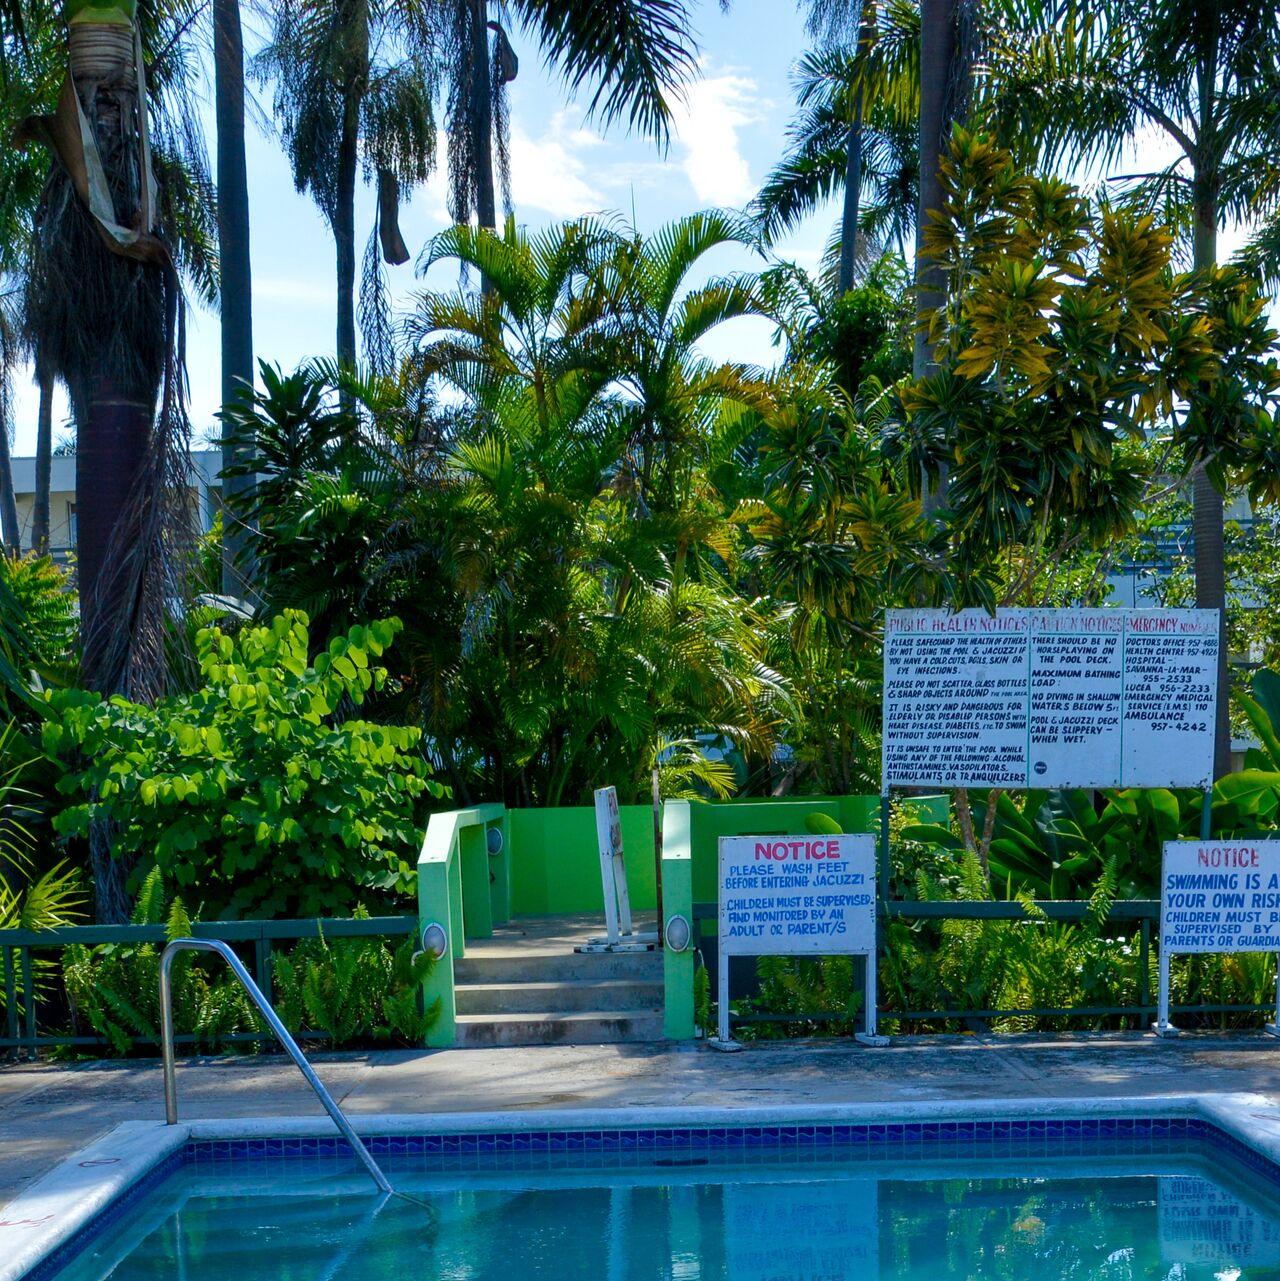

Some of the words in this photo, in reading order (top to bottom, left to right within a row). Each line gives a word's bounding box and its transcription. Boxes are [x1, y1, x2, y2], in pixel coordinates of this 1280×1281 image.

[891, 638, 913, 646] PLEASE
[957, 637, 969, 645] THE
[970, 637, 994, 645] HEALTH
[1057, 637, 1088, 645] SHOULD
[1090, 637, 1101, 645] BE
[940, 647, 951, 655] THE
[953, 647, 968, 655] POOL
[1018, 646, 1026, 654] IF
[1125, 647, 1154, 655] HEALTH
[889, 657, 901, 665] YOU
[903, 657, 921, 665] HAVE
[922, 657, 928, 665] A
[989, 656, 1009, 664] SKIN
[1012, 656, 1023, 664] OR
[1039, 655, 1054, 663] THE
[1086, 656, 1111, 664] DECK.
[896, 667, 909, 675] EYE
[915, 667, 961, 675] INFECTIONS.
[1084, 670, 1121, 678] BATHING
[1143, 675, 1192, 683] 955-2533
[888, 680, 913, 689] PLEASE
[915, 680, 925, 689] DO
[926, 680, 940, 688] NOT
[997, 679, 1027, 687] BOTTLES
[1160, 684, 1210, 693] 956-2233
[897, 689, 922, 698] SHARP
[923, 689, 953, 698] OBJECTS
[955, 688, 989, 698] AROUND
[1031, 693, 1044, 701] NO
[1046, 693, 1074, 701] DIVING
[1075, 693, 1084, 701] IN
[1087, 693, 1121, 701] SHALLOW
[1124, 693, 1173, 701] EMERGENCY
[1175, 694, 1214, 702] MEDICAL
[889, 704, 899, 712] IT
[902, 703, 912, 711] IS
[915, 703, 942, 711] RISKY
[942, 703, 959, 711] AND
[960, 702, 1004, 711] DANGEROUS
[1007, 702, 1022, 710] FOR
[1031, 702, 1070, 711] WATERS
[1072, 703, 1104, 711] BELOW
[1195, 703, 1208, 711] 110
[888, 713, 923, 721] ELDERLY
[938, 712, 973, 720] DISABLED
[974, 712, 1011, 720] PERSONS
[1030, 716, 1049, 724] POOL
[1058, 717, 1095, 725] JACUZZI
[1097, 717, 1119, 725] DECK
[1124, 712, 1185, 720] AMBULANCE
[888, 722, 909, 730] HEART
[1030, 726, 1047, 734] CAN
[1048, 726, 1059, 734] BE
[1062, 726, 1103, 734] SLIPPERY
[1151, 722, 1207, 731] 957-4242
[888, 731, 924, 739] WITHOUT
[1031, 735, 1058, 743] WHEN
[905, 745, 930, 753] UNSAFE
[932, 745, 941, 753] TO
[942, 745, 962, 753] ENTER
[886, 771, 943, 780] STIMULANTS
[945, 772, 957, 780] OR
[755, 840, 841, 861] NOTICE
[1197, 847, 1260, 868] NOTICE
[729, 864, 774, 877] PLEASE
[782, 864, 813, 875] WASH
[817, 861, 850, 874] FEET
[725, 876, 759, 890] BEFORE
[761, 875, 810, 889] ENTERING
[813, 873, 865, 887] JACUZZI
[1166, 873, 1238, 890] SWIMMING
[1245, 873, 1261, 890] IS
[726, 898, 774, 911] CHILDREN
[777, 896, 801, 909] MUST
[804, 896, 815, 908] BE
[1166, 893, 1206, 909] YOUR
[1212, 893, 1245, 909] OWN
[728, 912, 750, 923] AND
[753, 910, 808, 922] MONITORED
[811, 909, 826, 921] BY
[829, 908, 844, 920] AN
[1166, 912, 1220, 923] CHILDREN
[1225, 911, 1262, 923] MUST
[729, 925, 765, 936] ADULT
[770, 924, 783, 936] OR
[787, 921, 846, 936] PARENT/S
[1174, 924, 1241, 935] SUPERVISED
[1253, 924, 1273, 935] BY
[1164, 935, 1215, 947] PARENTS
[1218, 935, 1233, 946] OR
